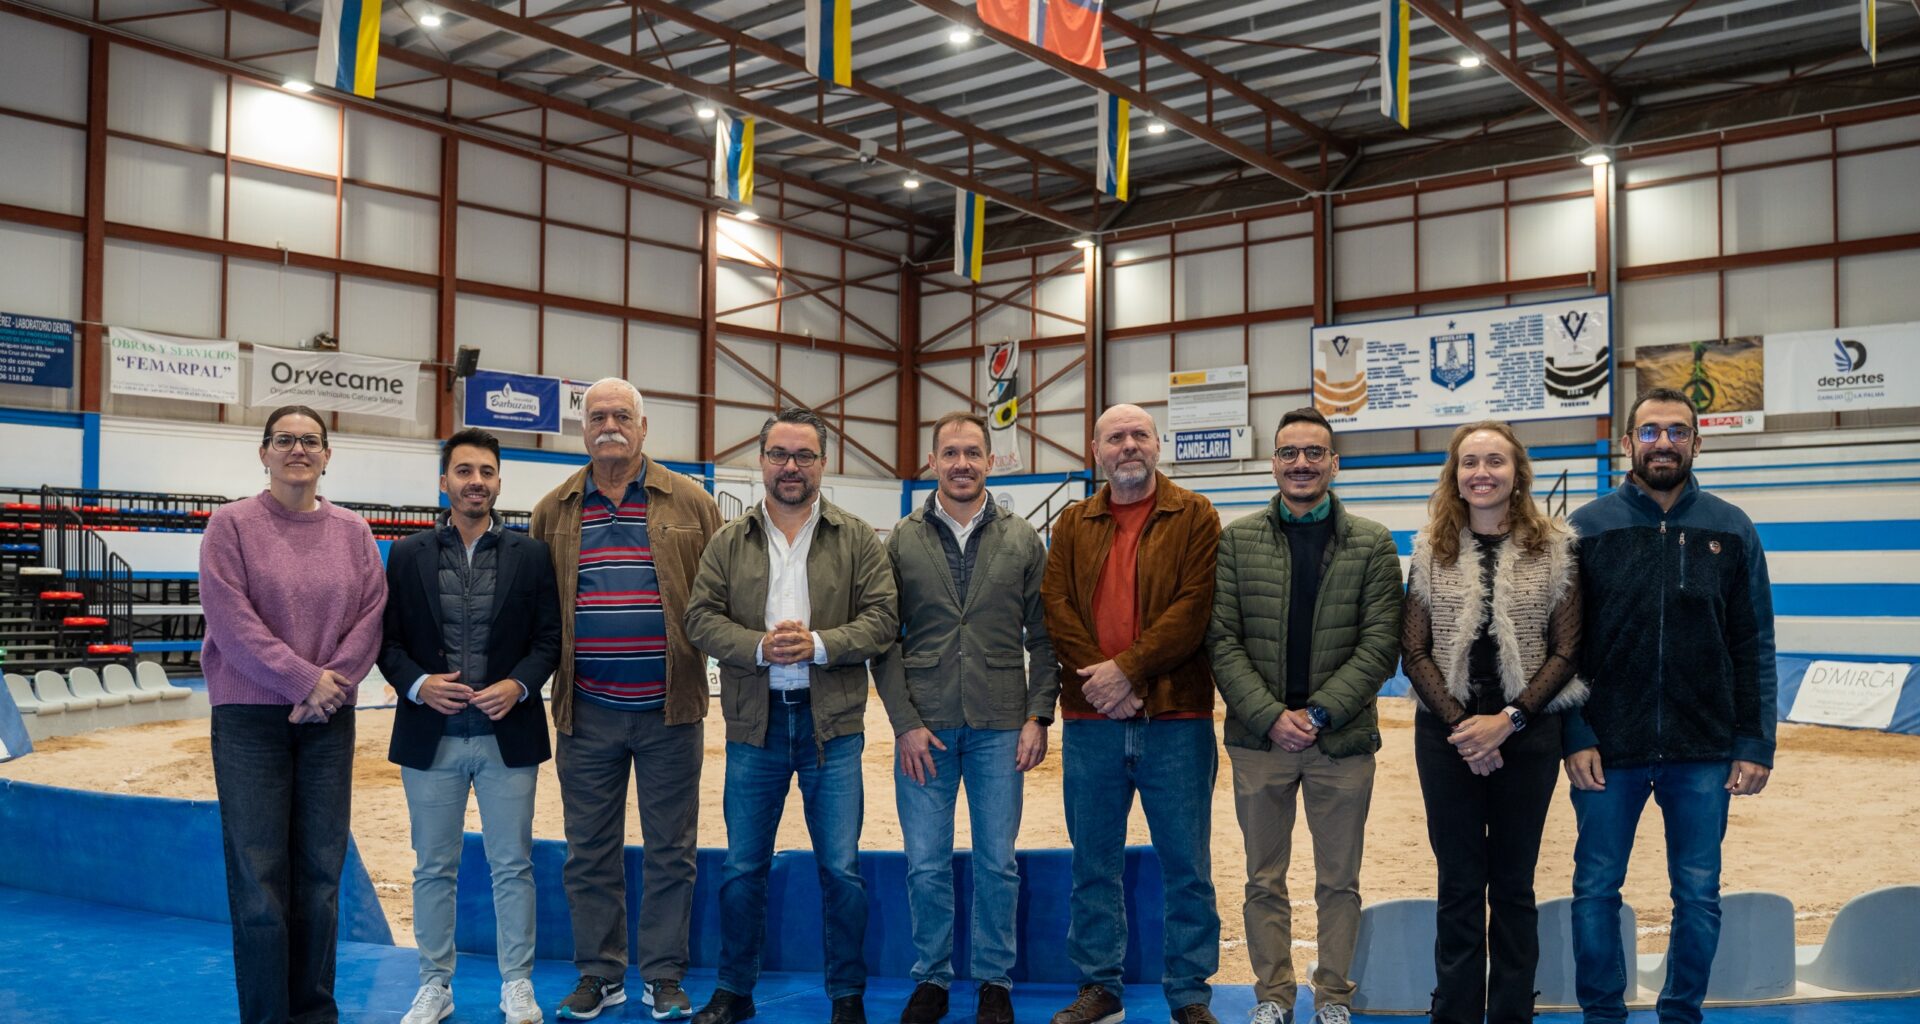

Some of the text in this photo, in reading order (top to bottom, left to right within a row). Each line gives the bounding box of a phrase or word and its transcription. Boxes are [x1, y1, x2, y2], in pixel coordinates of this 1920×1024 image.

[15, 318, 52, 332] LABORATORIO
[53, 322, 72, 334] DENTAL
[112, 337, 236, 360] OBRAS Y SERVICIOS
[271, 361, 404, 394] Orvecame
[1818, 373, 1884, 387] deportes
[490, 394, 537, 411] Barbuzano
[1708, 416, 1742, 426] SPAR
[1164, 434, 1170, 442] L
[1237, 429, 1244, 438] V
[1177, 440, 1229, 459] CANDELARIA
[1811, 667, 1894, 688] D'MIRCA
